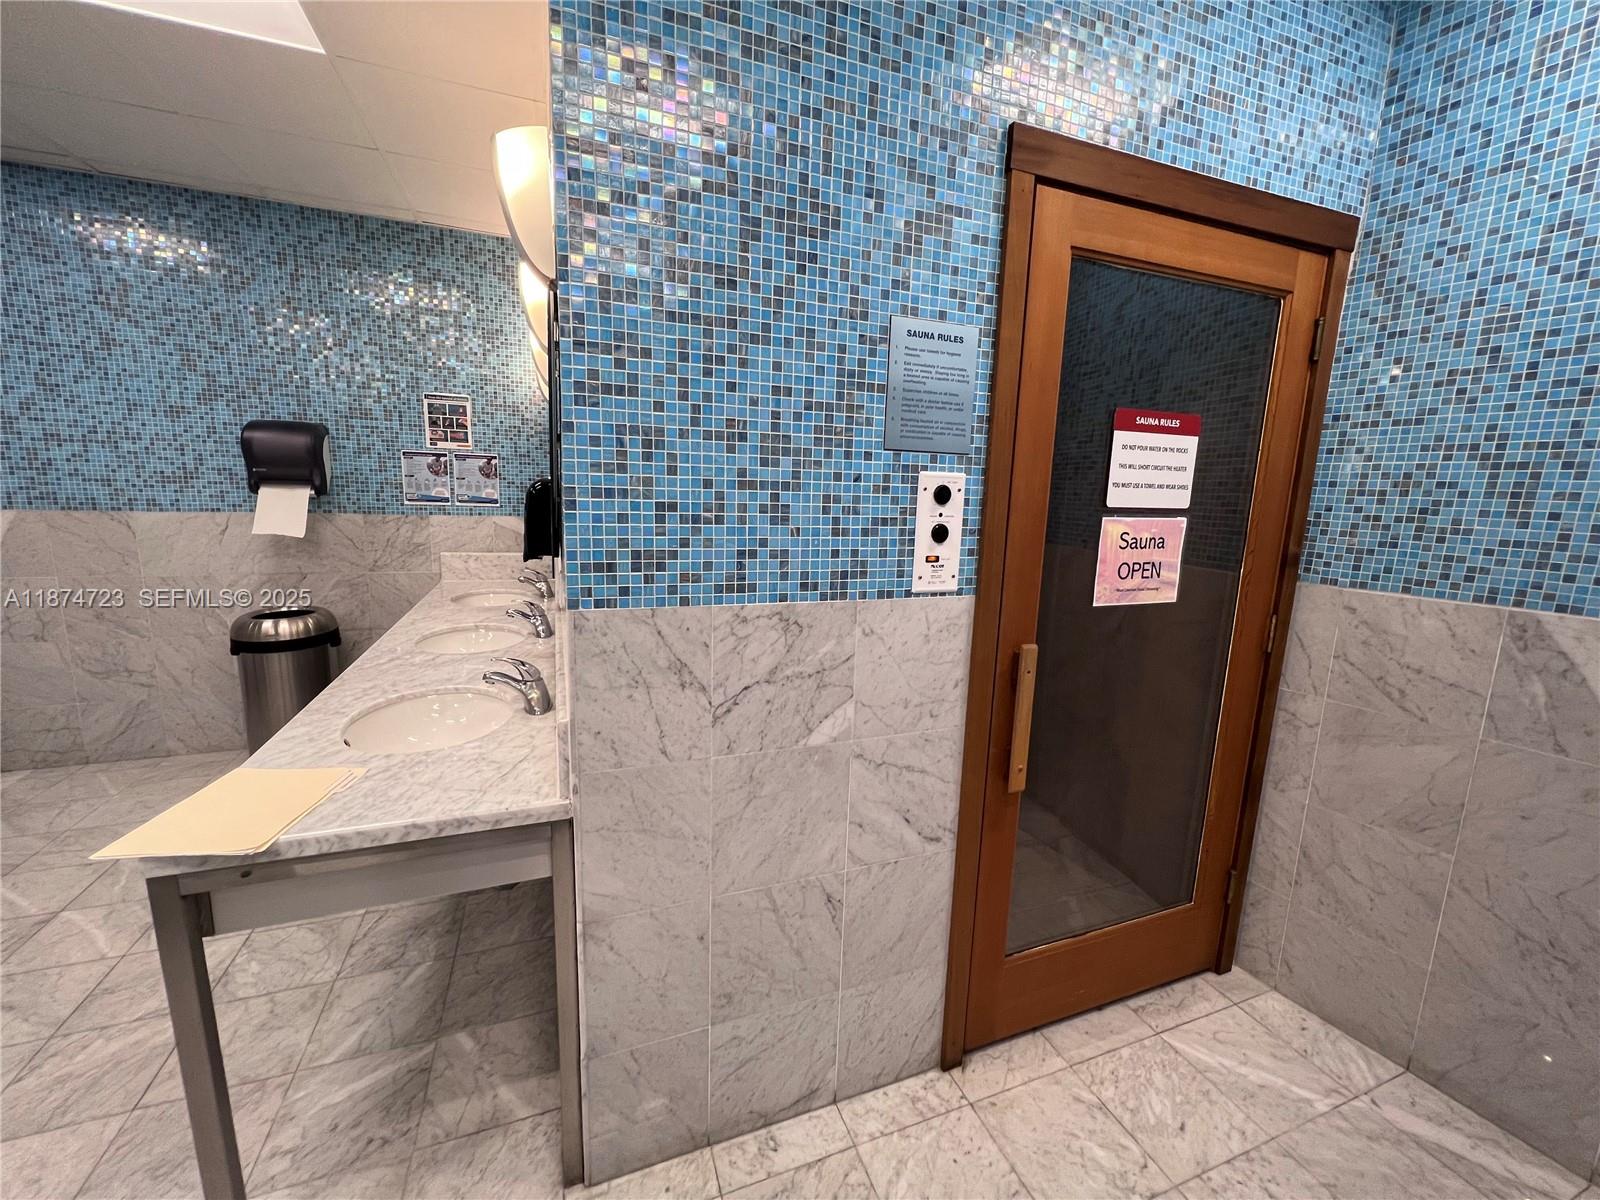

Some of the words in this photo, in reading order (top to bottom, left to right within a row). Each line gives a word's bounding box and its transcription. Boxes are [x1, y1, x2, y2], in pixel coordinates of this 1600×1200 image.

[906, 330, 935, 340] SAUNA
[938, 334, 964, 344] RULES
[1136, 417, 1159, 426] SAUNA
[1160, 419, 1180, 427] RULES
[1119, 532, 1165, 549] Sauna
[1118, 561, 1161, 580] OPEN
